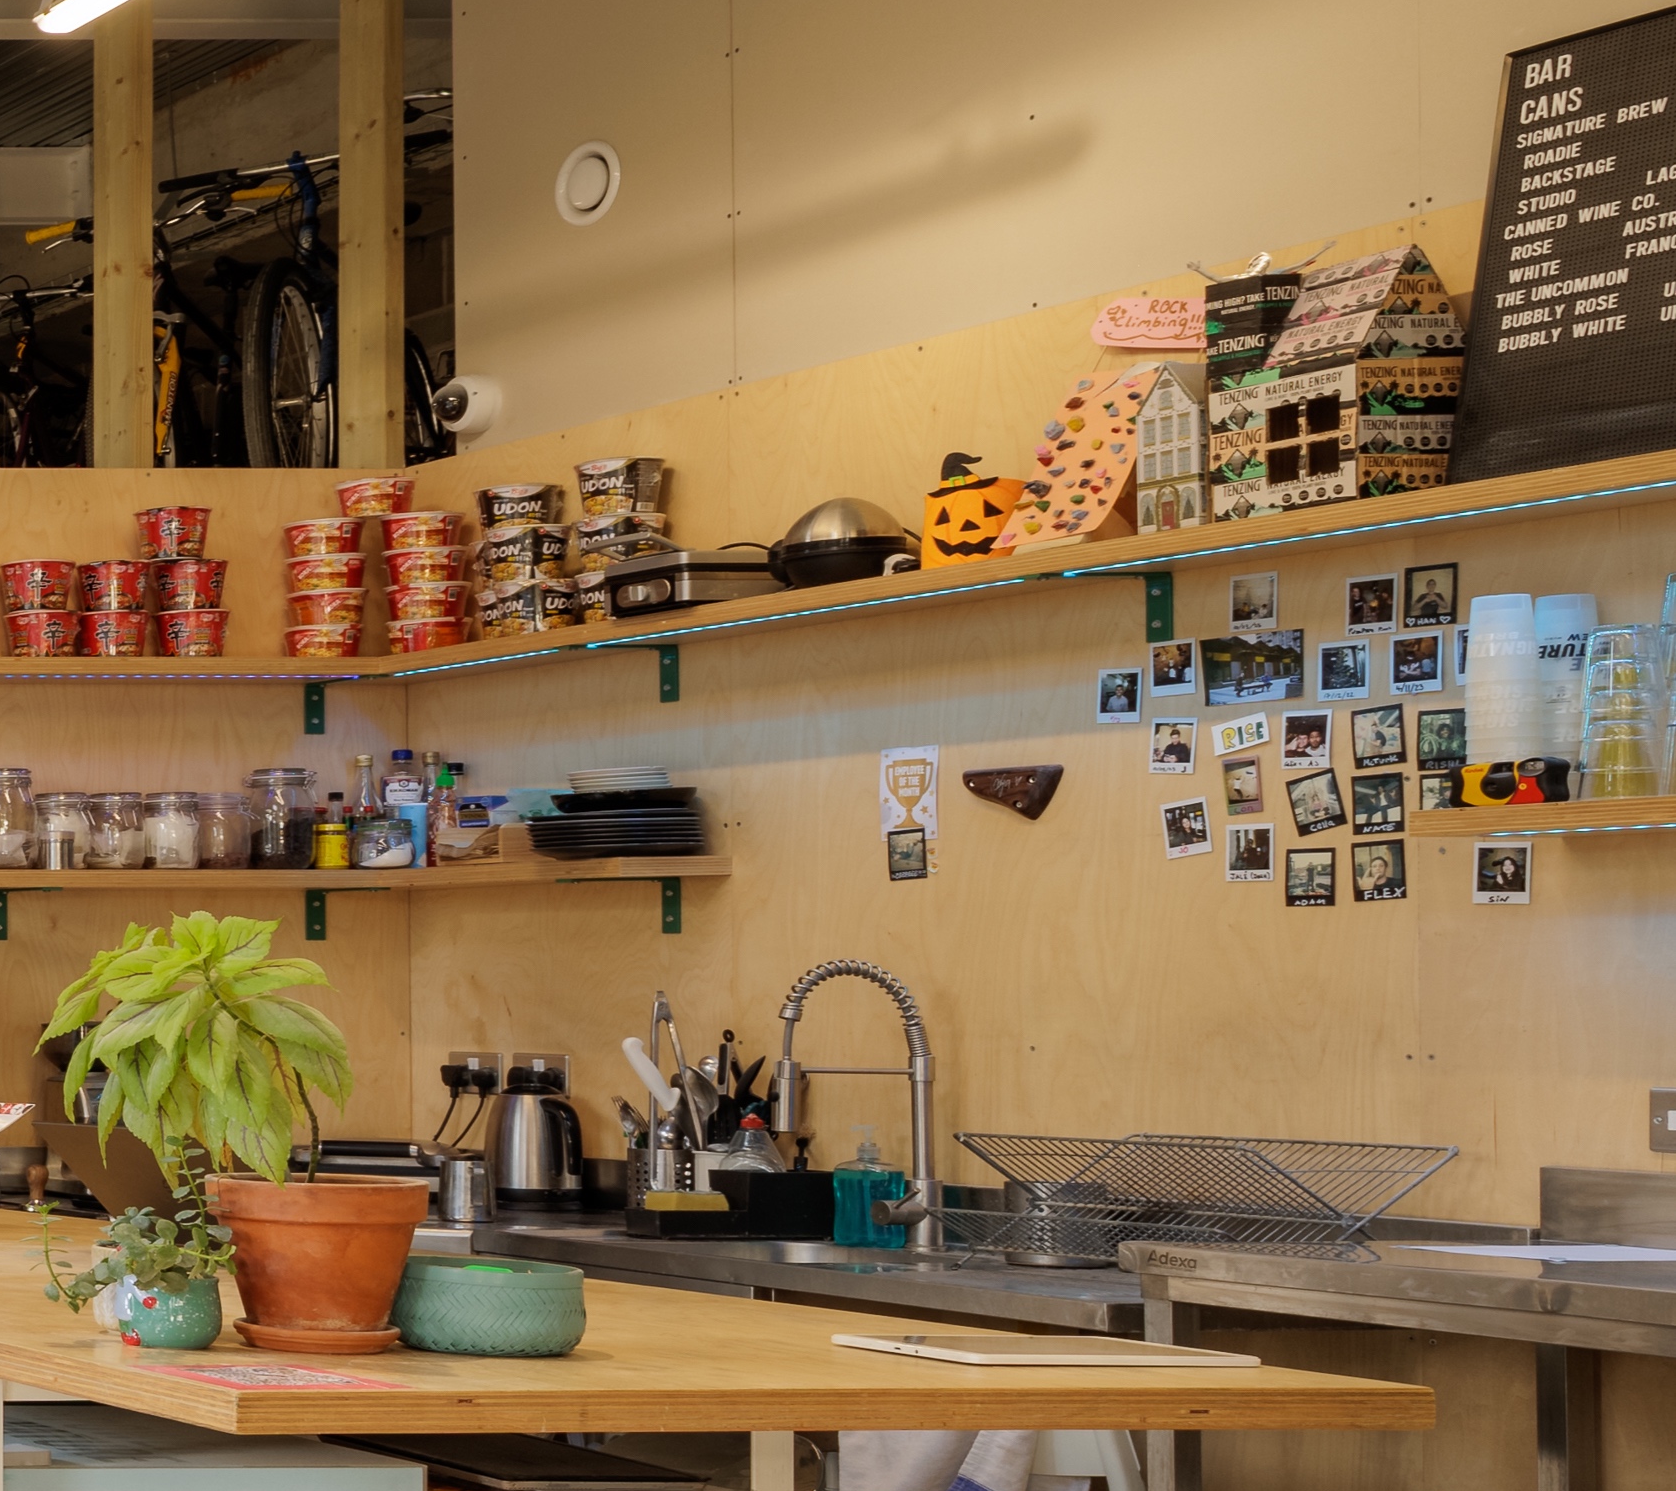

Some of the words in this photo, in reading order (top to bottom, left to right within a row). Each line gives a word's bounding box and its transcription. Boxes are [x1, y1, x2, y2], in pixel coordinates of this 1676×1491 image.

[1524, 54, 1572, 89] BAR
[1520, 87, 1583, 124] CANS
[1516, 113, 1606, 148] SIGNATURE
[1617, 97, 1668, 124] BREW
[1524, 142, 1581, 170] ROADIE
[1520, 156, 1616, 192] BACKSTAGE
[1504, 213, 1568, 240] CANNED
[1578, 201, 1621, 224] WINE
[1632, 193, 1660, 212] CO.
[1517, 189, 1576, 215] STUDIO
[1510, 239, 1552, 262] ROSE
[1508, 260, 1560, 284] WHITE
[1496, 290, 1526, 309] THE
[1531, 268, 1628, 302] UNCOMMON
[1148, 300, 1188, 313] ROCK
[1502, 304, 1565, 329] BUBBLY
[1575, 293, 1618, 316] ROSE
[1498, 327, 1561, 353] BUBBLY
[1573, 316, 1626, 338] WHITE
[1219, 386, 1260, 406] TENZING
[1265, 380, 1305, 396] NATURAL
[1309, 371, 1343, 388] ENERGY
[581, 476, 624, 493] UDON
[1222, 722, 1264, 749] RISE
[1364, 887, 1405, 900] FLEX
[1147, 1249, 1197, 1270] Adexa
